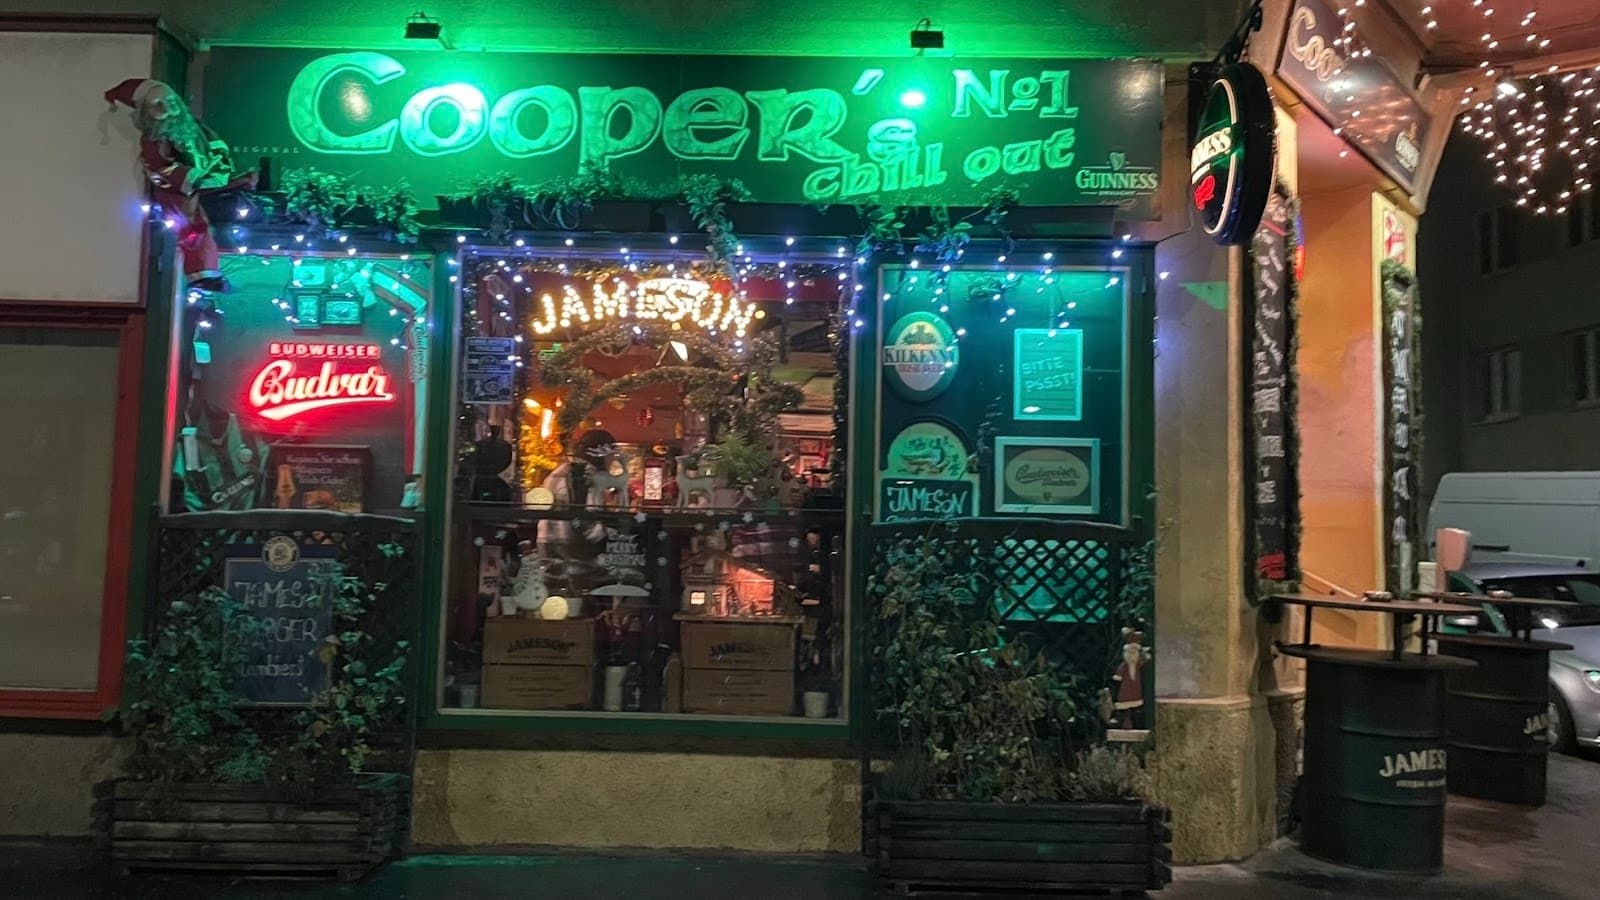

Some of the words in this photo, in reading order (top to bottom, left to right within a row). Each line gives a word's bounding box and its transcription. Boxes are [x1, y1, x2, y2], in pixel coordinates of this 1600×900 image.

[803, 142, 948, 202] chill
[962, 127, 1077, 182] out
[1075, 169, 1159, 190] GUINNESS
[532, 280, 757, 338] JAMESON
[269, 342, 381, 359] BUDWEISER
[884, 349, 956, 363] KILKENN
[1022, 356, 1064, 376] BITTE
[250, 359, 394, 410] Budvar
[886, 487, 968, 514] JAMESON
